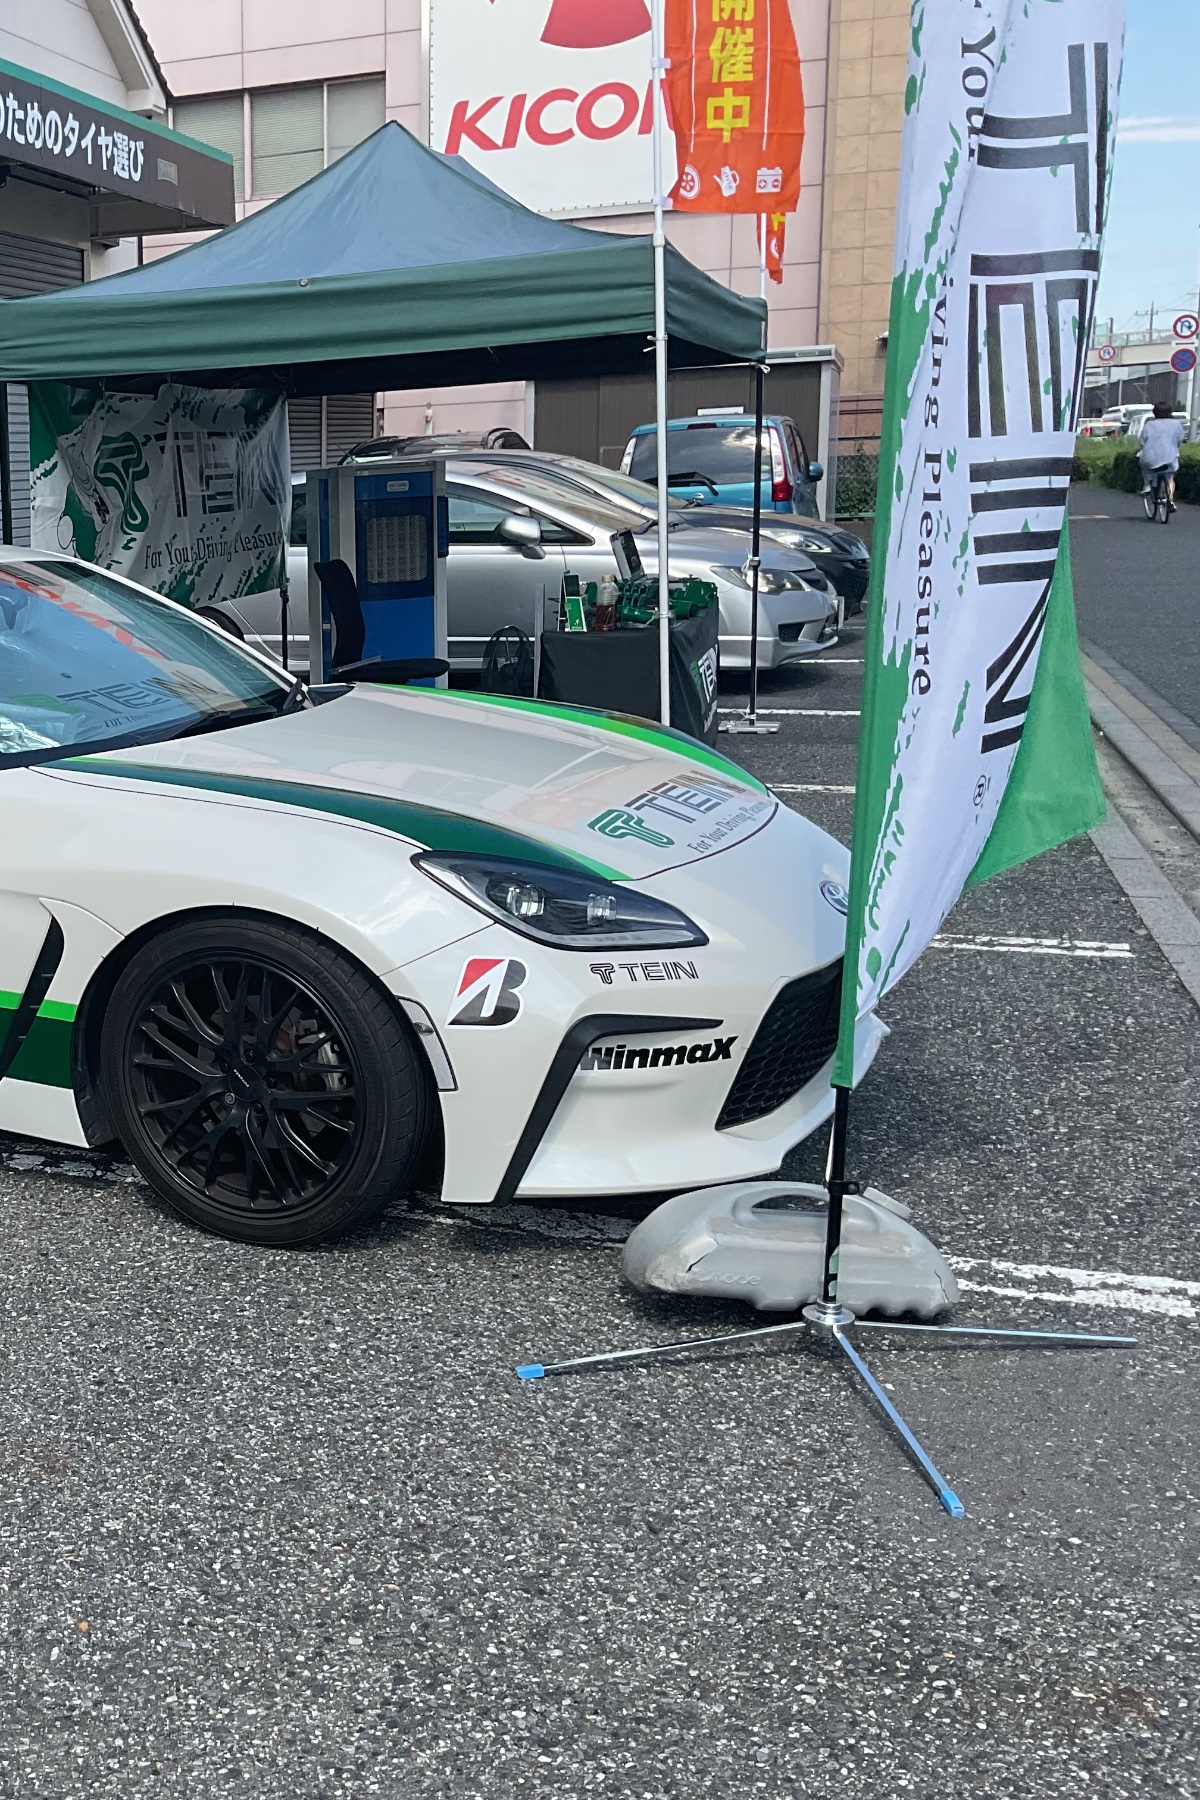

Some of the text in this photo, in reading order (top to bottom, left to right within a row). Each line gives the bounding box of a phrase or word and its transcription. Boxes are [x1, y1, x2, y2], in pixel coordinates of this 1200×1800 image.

[145, 545, 162, 569] For
[911, 450, 944, 697] Pleasure
[624, 770, 748, 824] TEIN
[618, 960, 700, 982] TEIN
